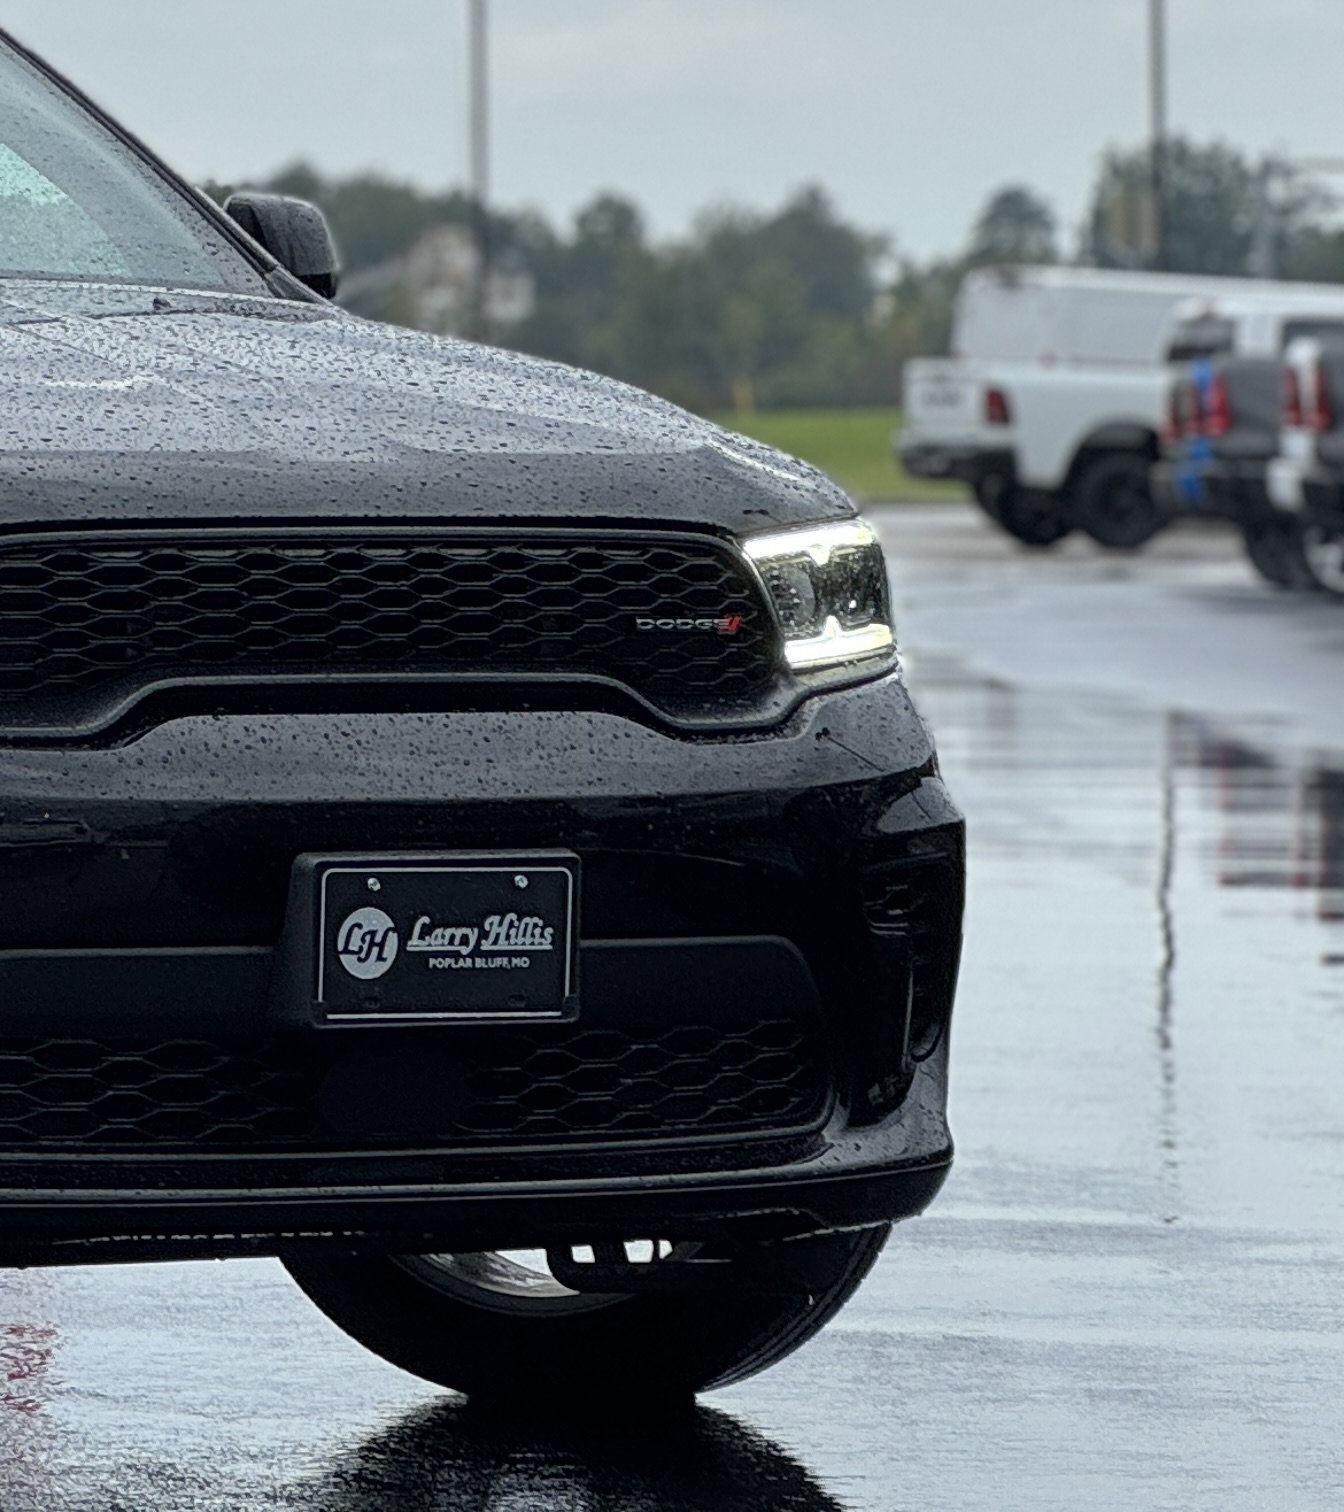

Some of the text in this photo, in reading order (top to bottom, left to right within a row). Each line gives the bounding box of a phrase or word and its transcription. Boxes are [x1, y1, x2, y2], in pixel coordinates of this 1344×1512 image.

[636, 618, 729, 630] DODGE
[407, 912, 554, 955] Larry Hillis
[428, 957, 473, 969] POPLAR
[512, 957, 530, 968] MO
